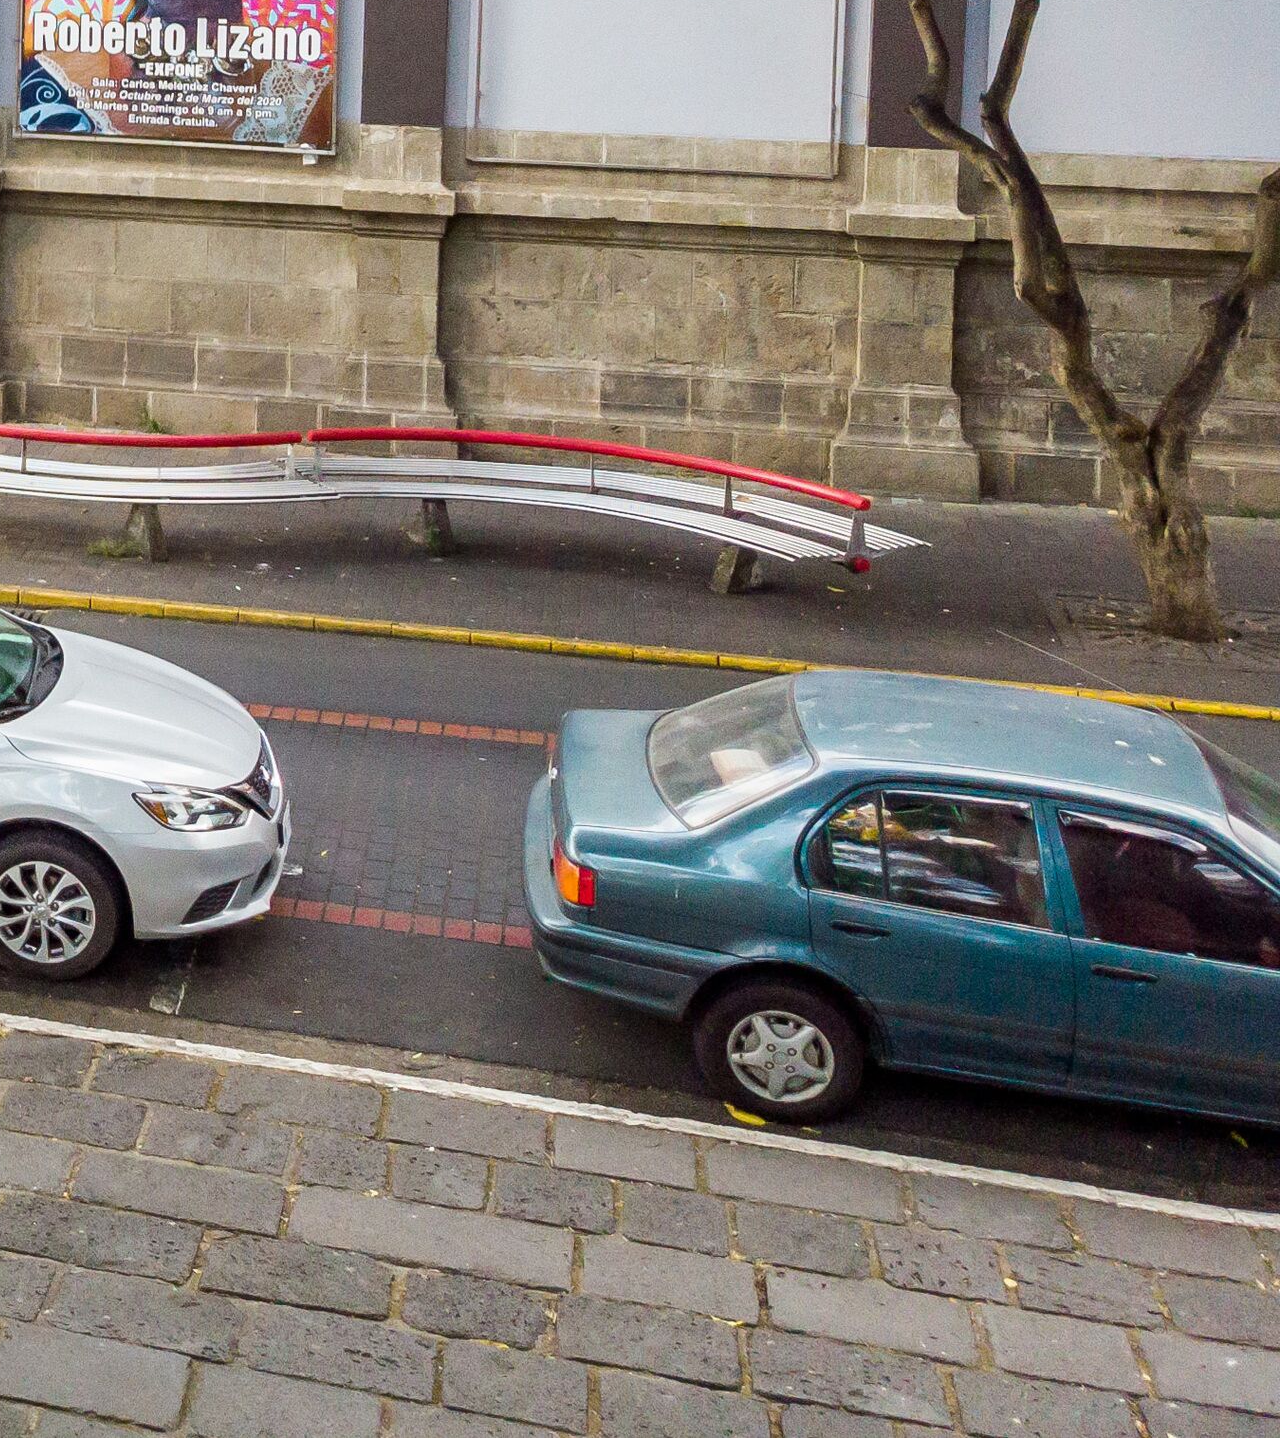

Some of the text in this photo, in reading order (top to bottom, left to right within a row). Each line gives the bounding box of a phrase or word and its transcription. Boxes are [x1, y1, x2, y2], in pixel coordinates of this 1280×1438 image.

[33, 12, 321, 61] Roberto Lizano
[92, 77, 118, 88] Sala:
[121, 78, 155, 89] Carlos
[212, 82, 257, 94] Chaverri
[68, 88, 282, 106] Del 19 de Octubre al 2 de Marzo del 2020
[76, 99, 90, 109] De
[94, 101, 129, 111] Martes
[141, 102, 188, 115] Domingo
[191, 105, 205, 115] de
[208, 106, 214, 115] 9
[217, 108, 233, 116] am
[236, 109, 243, 117] a
[255, 110, 272, 119] pm
[128, 114, 218, 127] Entrada Gratuita.
